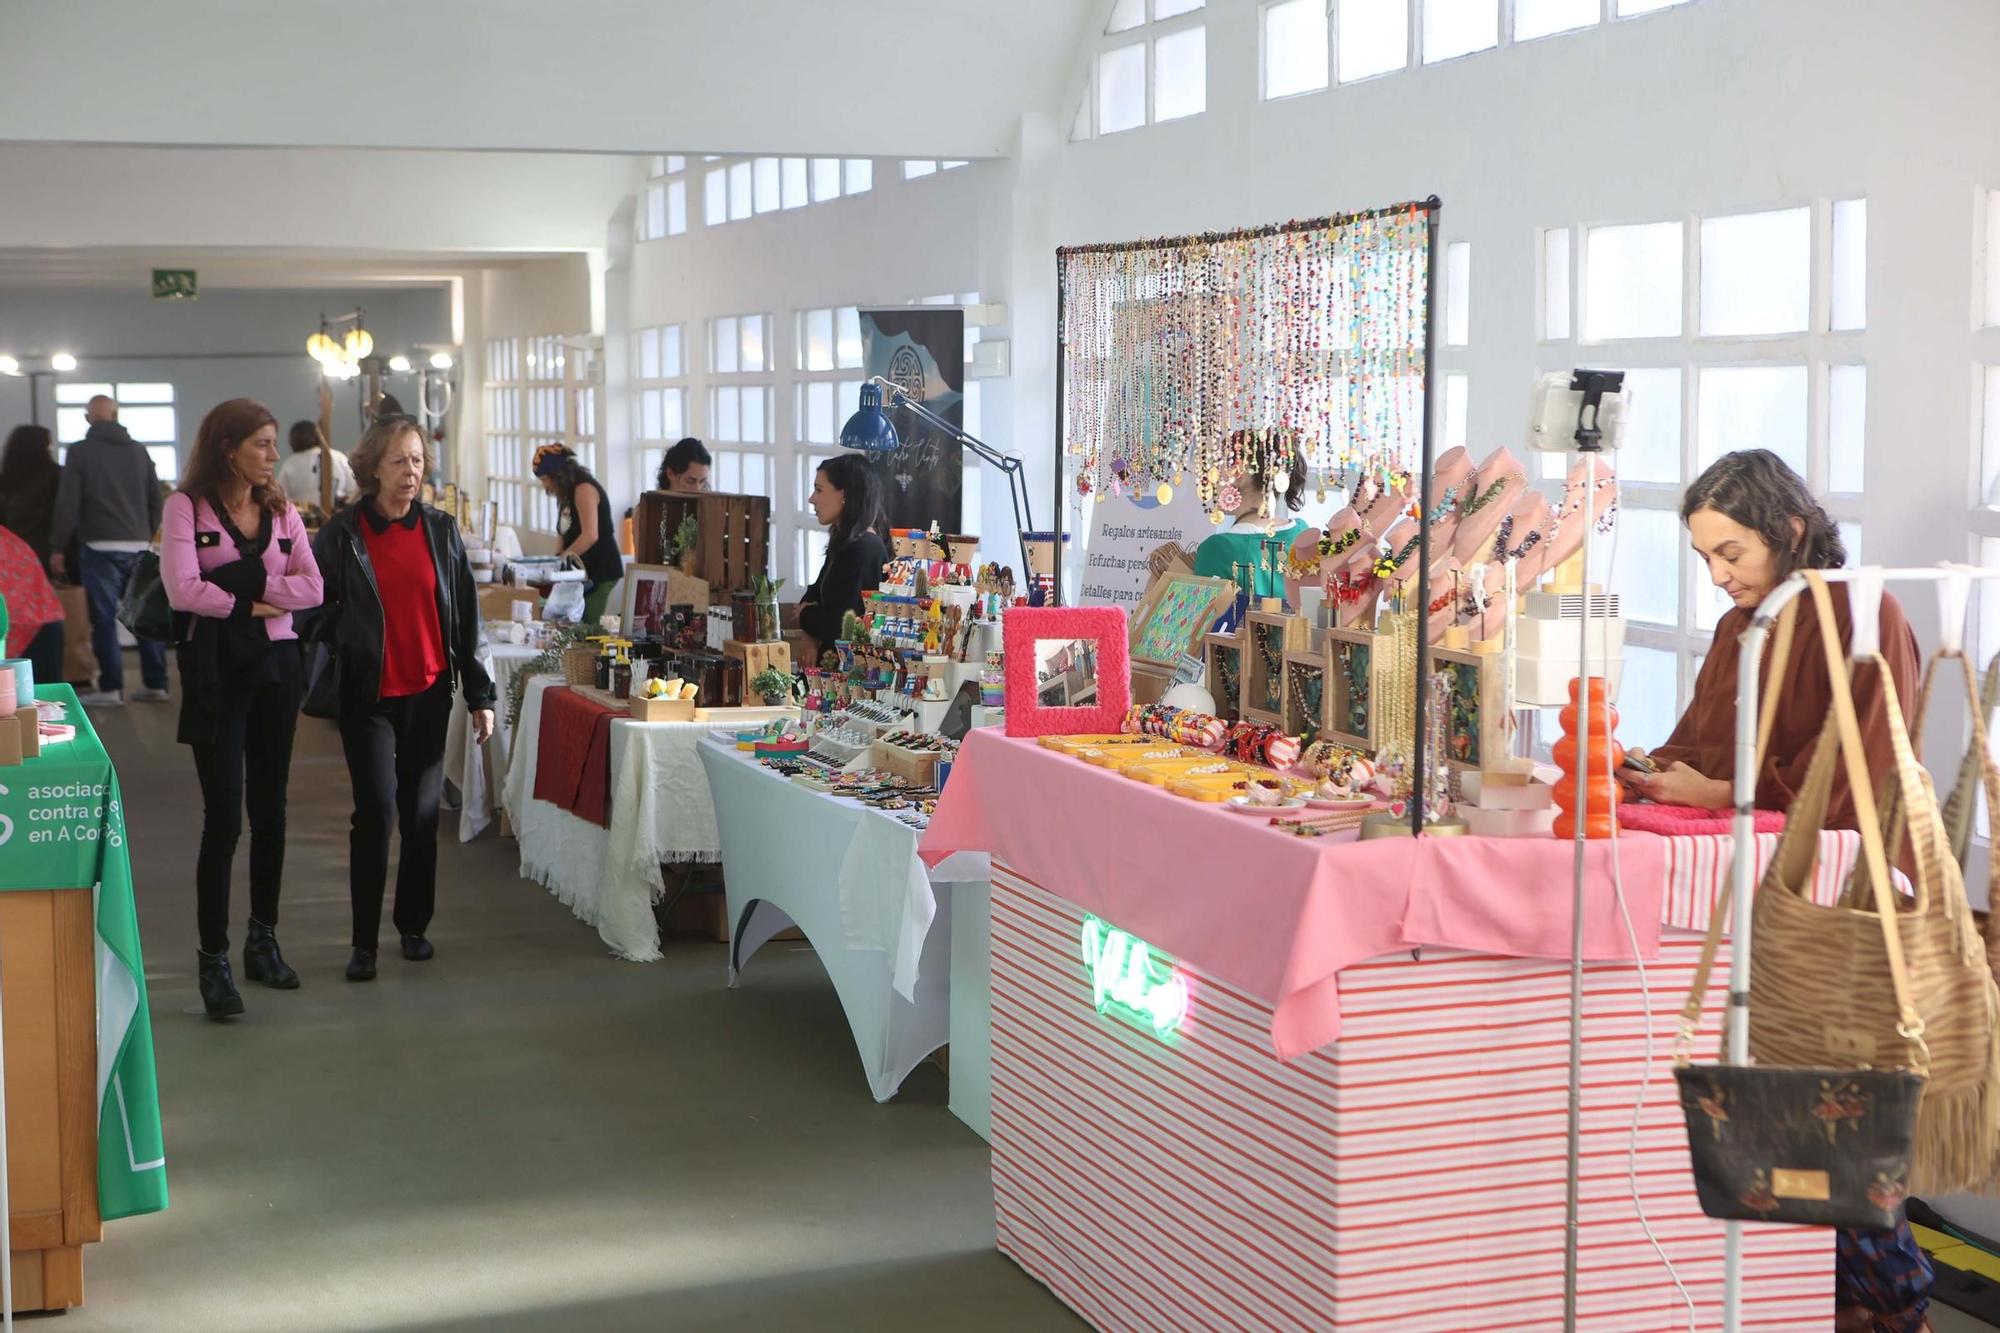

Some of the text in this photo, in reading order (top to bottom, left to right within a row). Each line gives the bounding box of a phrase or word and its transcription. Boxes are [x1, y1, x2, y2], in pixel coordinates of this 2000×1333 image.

[1102, 523, 1183, 541] Regalos artesanales
[1088, 553, 1126, 568] Fofuchas
[1113, 589, 1133, 603] para
[28, 803, 89, 821] contra
[28, 830, 53, 843] en
[57, 825, 71, 841] A
